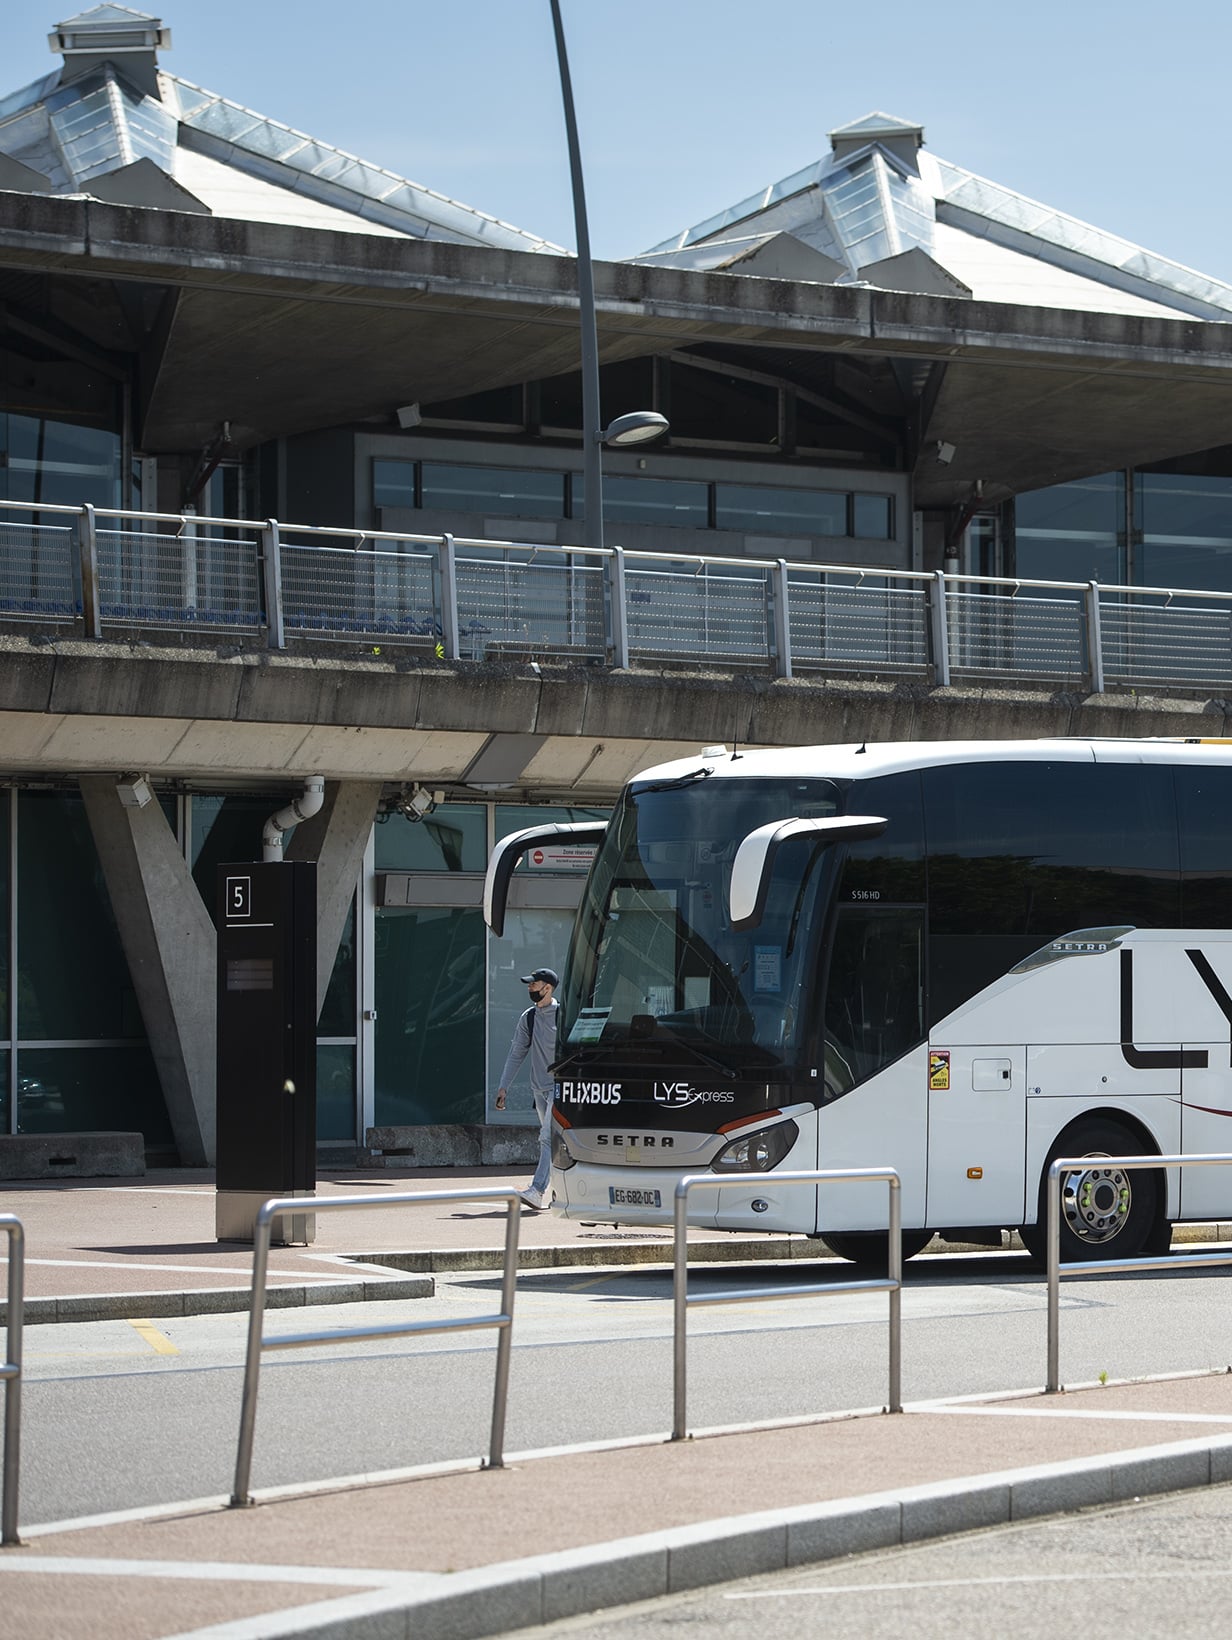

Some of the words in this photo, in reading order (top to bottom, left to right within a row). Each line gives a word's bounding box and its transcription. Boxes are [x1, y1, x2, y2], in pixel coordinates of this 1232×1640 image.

[233, 886, 244, 908] 5
[1052, 943, 1107, 951] SETRA
[597, 1135, 675, 1148] SETRA
